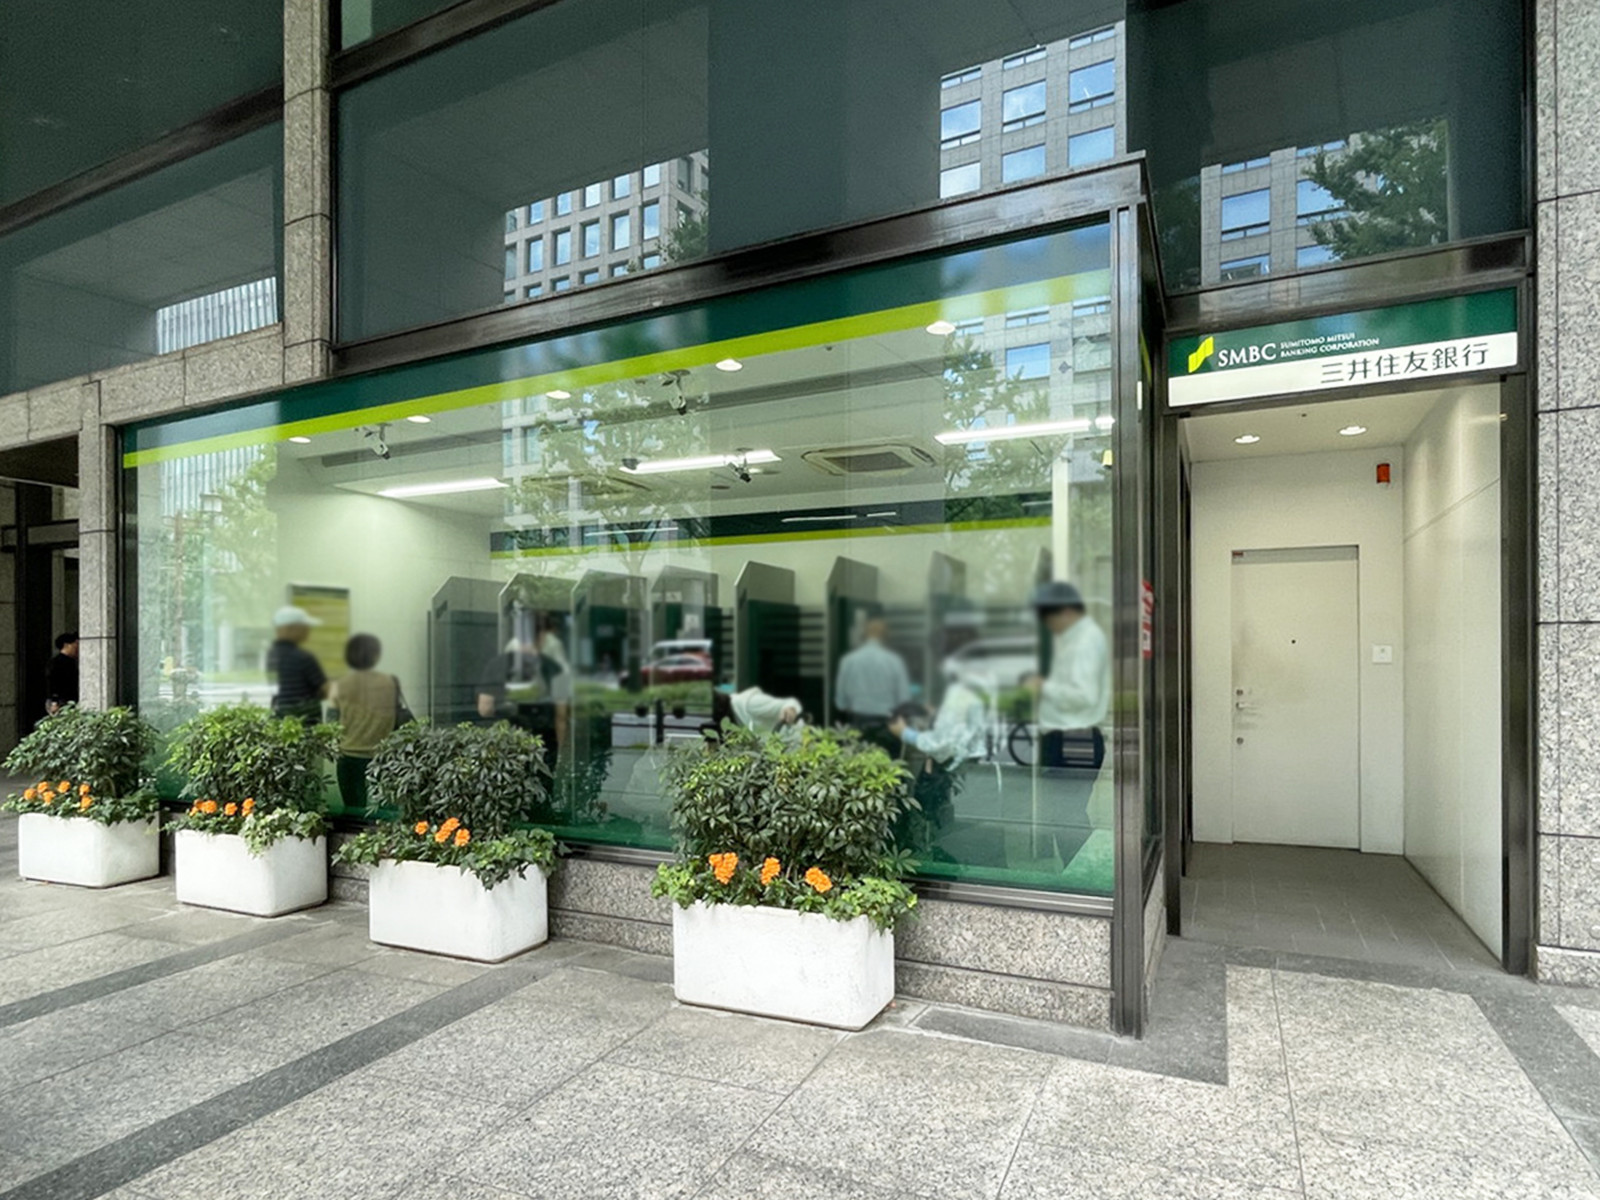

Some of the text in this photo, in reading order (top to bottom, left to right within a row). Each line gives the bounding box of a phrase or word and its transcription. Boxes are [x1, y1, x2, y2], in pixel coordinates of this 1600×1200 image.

[1280, 332, 1356, 349] SUMITOMO MITSUI
[1280, 338, 1380, 358] BANKING CORPORATION
[1218, 342, 1277, 368] SMBC
[1321, 342, 1489, 384] 三井住友銀行
